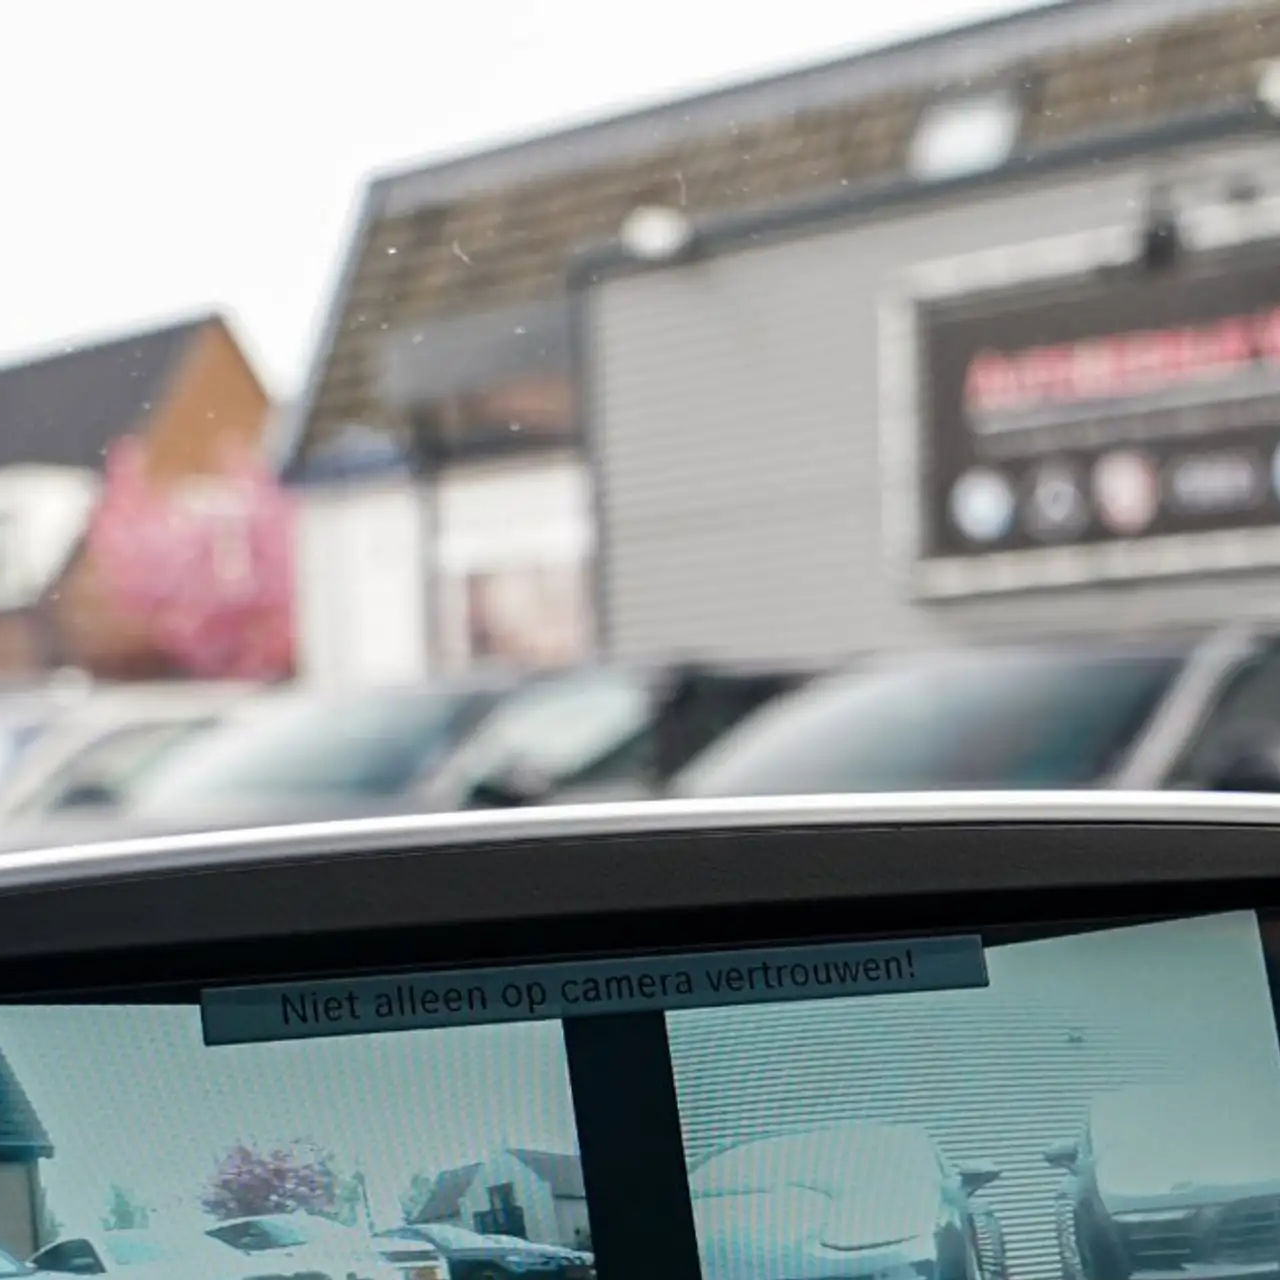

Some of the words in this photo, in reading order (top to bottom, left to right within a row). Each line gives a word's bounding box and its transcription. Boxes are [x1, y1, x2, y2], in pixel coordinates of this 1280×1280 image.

[281, 985, 360, 1025] Niet
[374, 984, 487, 1019] alleen
[501, 980, 547, 1013] op
[561, 970, 693, 1005] camera
[705, 949, 916, 992] vertrouwen!
